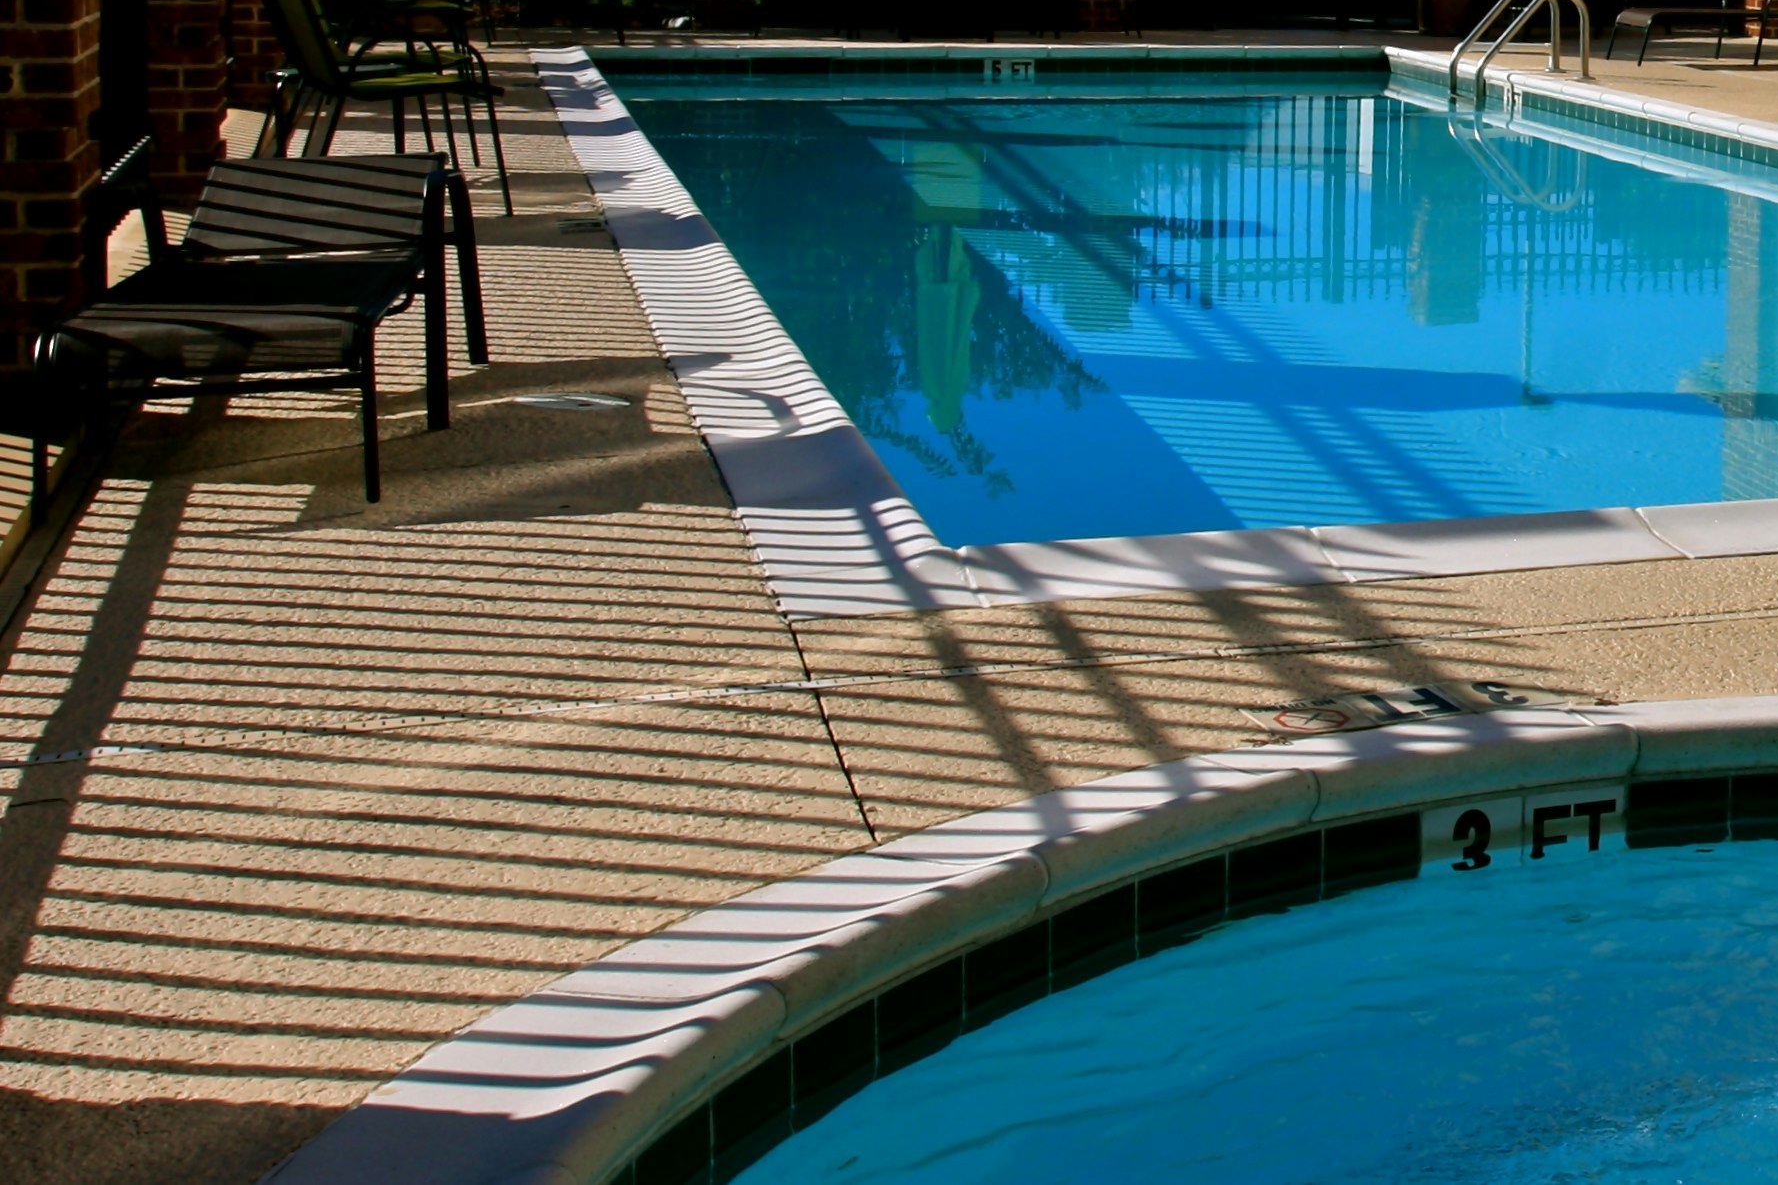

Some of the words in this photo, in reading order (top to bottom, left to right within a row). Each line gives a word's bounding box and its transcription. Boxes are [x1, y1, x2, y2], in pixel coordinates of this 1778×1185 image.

[1362, 687, 1465, 721] FT
[1471, 681, 1529, 706] 3
[1451, 808, 1492, 871] 3
[1530, 799, 1616, 859] FT
